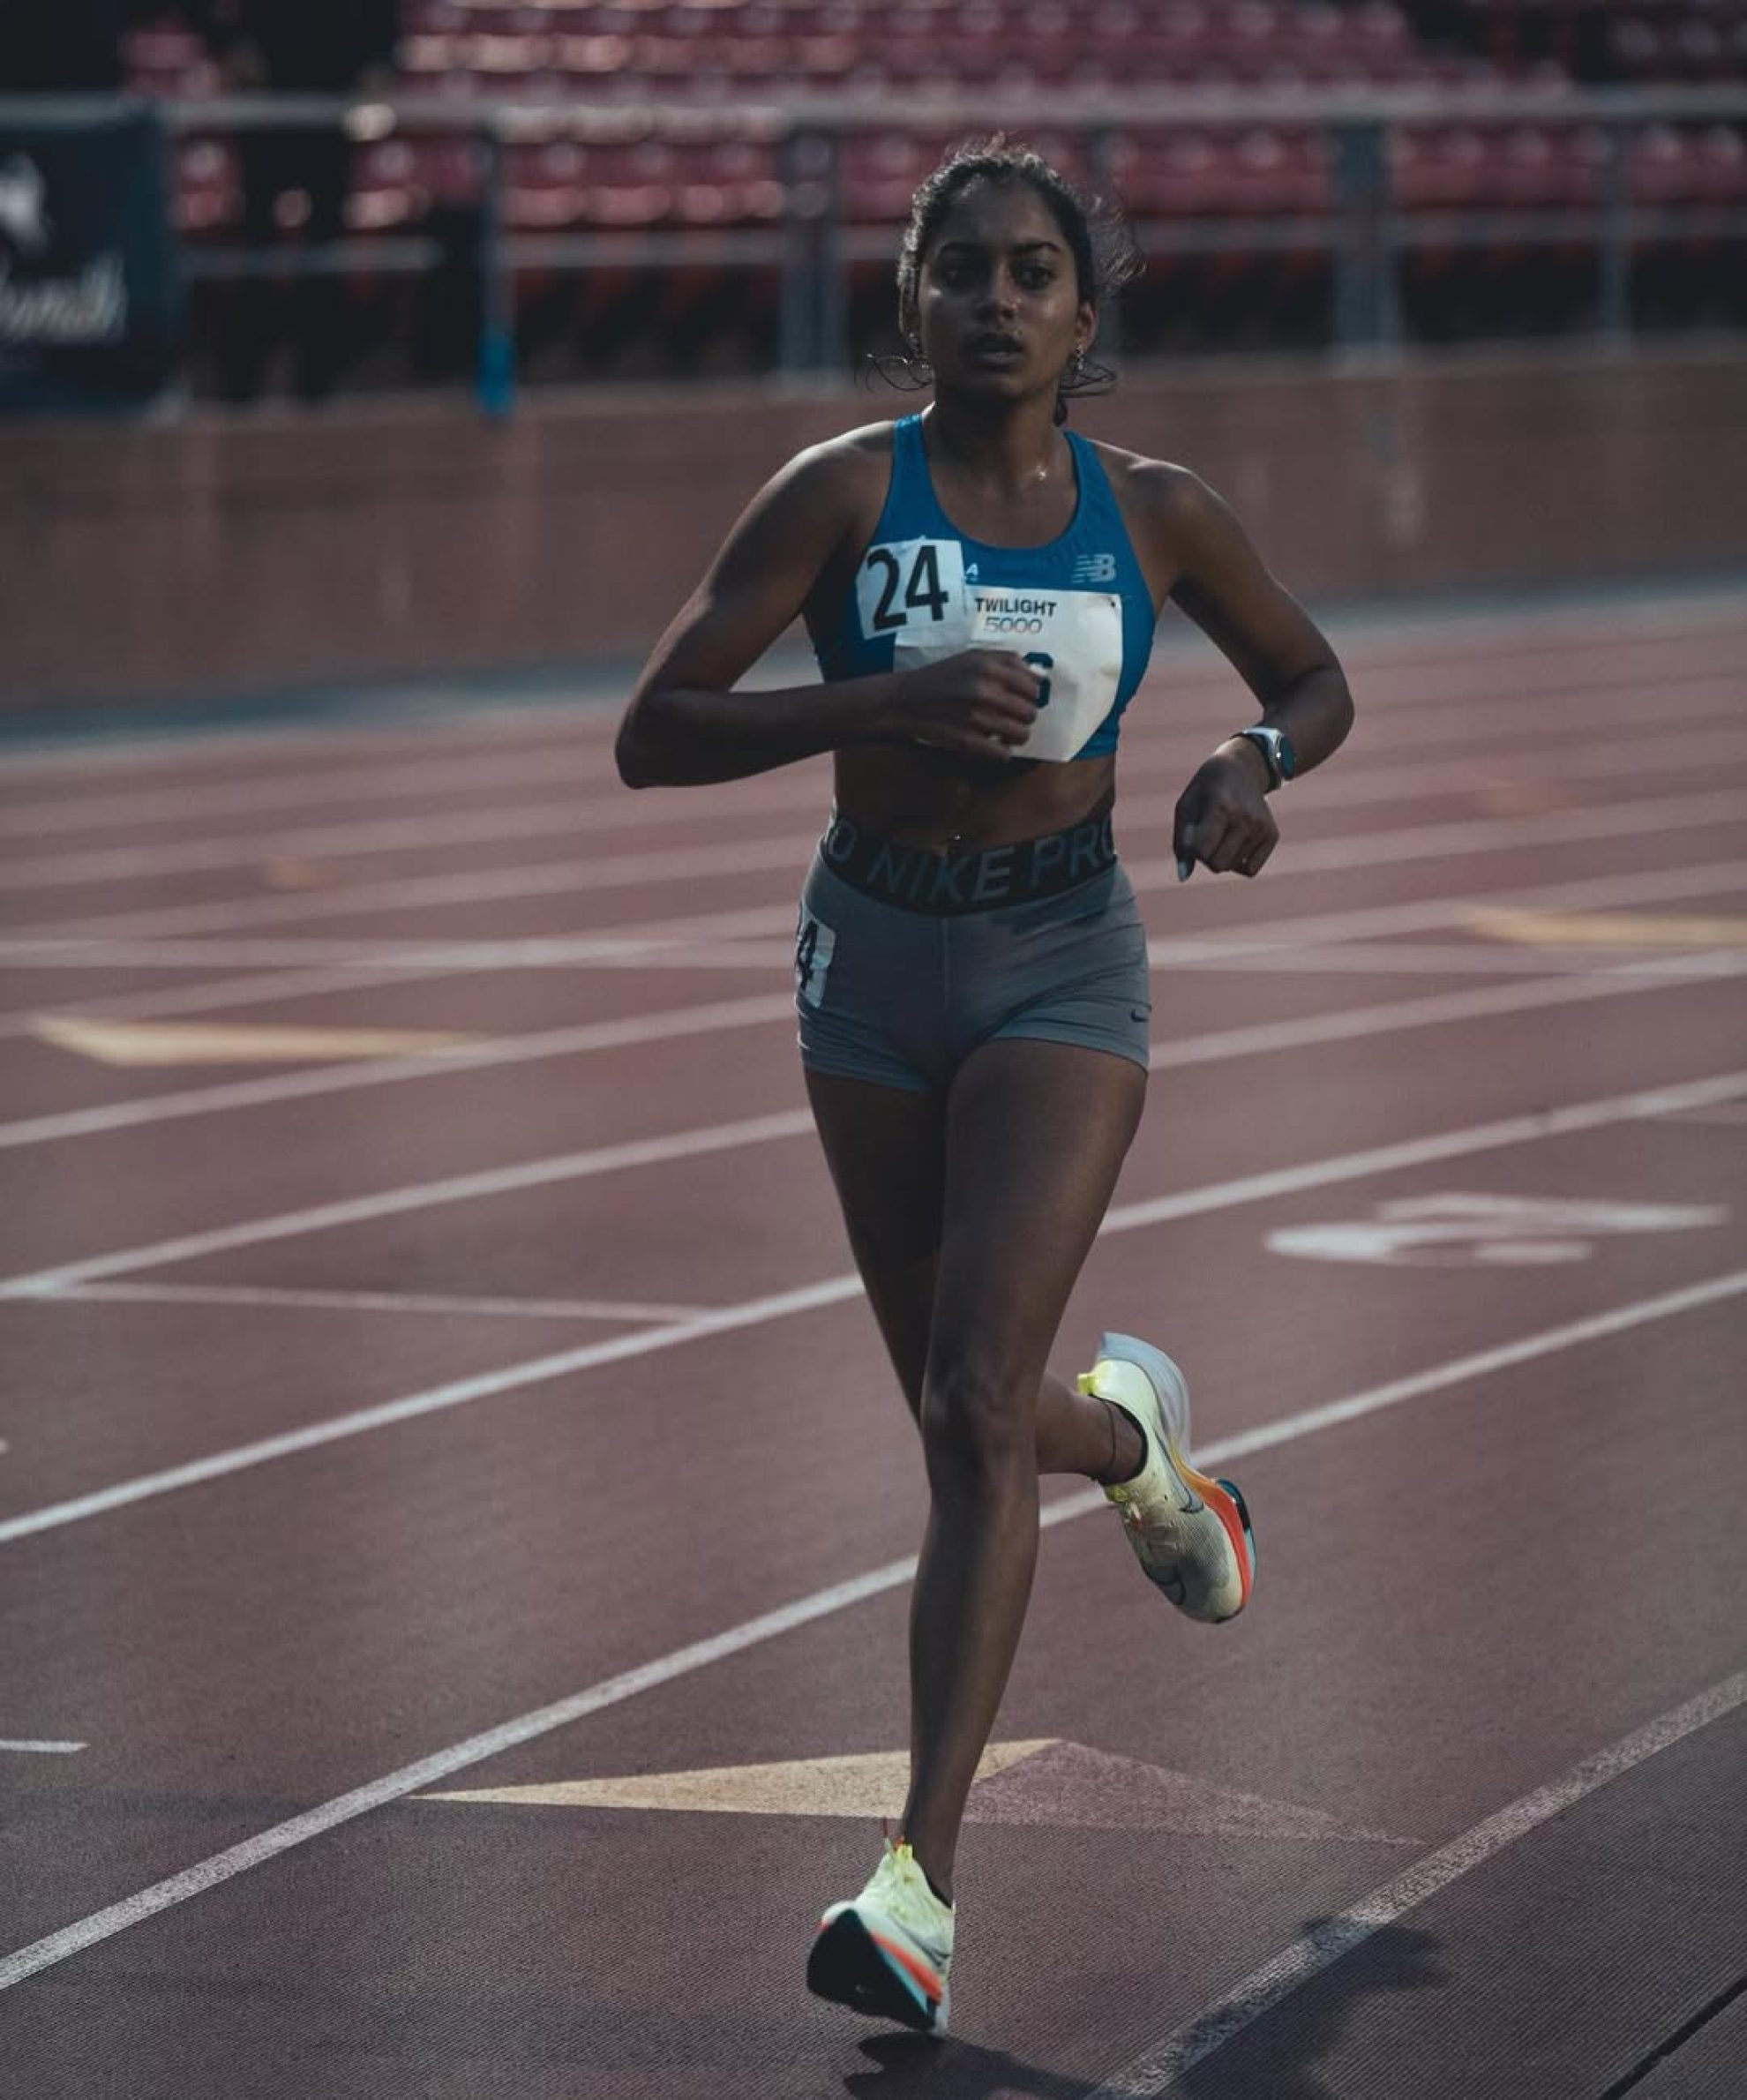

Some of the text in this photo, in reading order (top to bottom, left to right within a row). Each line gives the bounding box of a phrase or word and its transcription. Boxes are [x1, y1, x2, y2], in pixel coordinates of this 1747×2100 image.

[866, 545, 949, 632] 24
[975, 597, 1057, 617] TWILIGHT
[985, 617, 1043, 634] 5000
[866, 844, 1016, 905] NIKE
